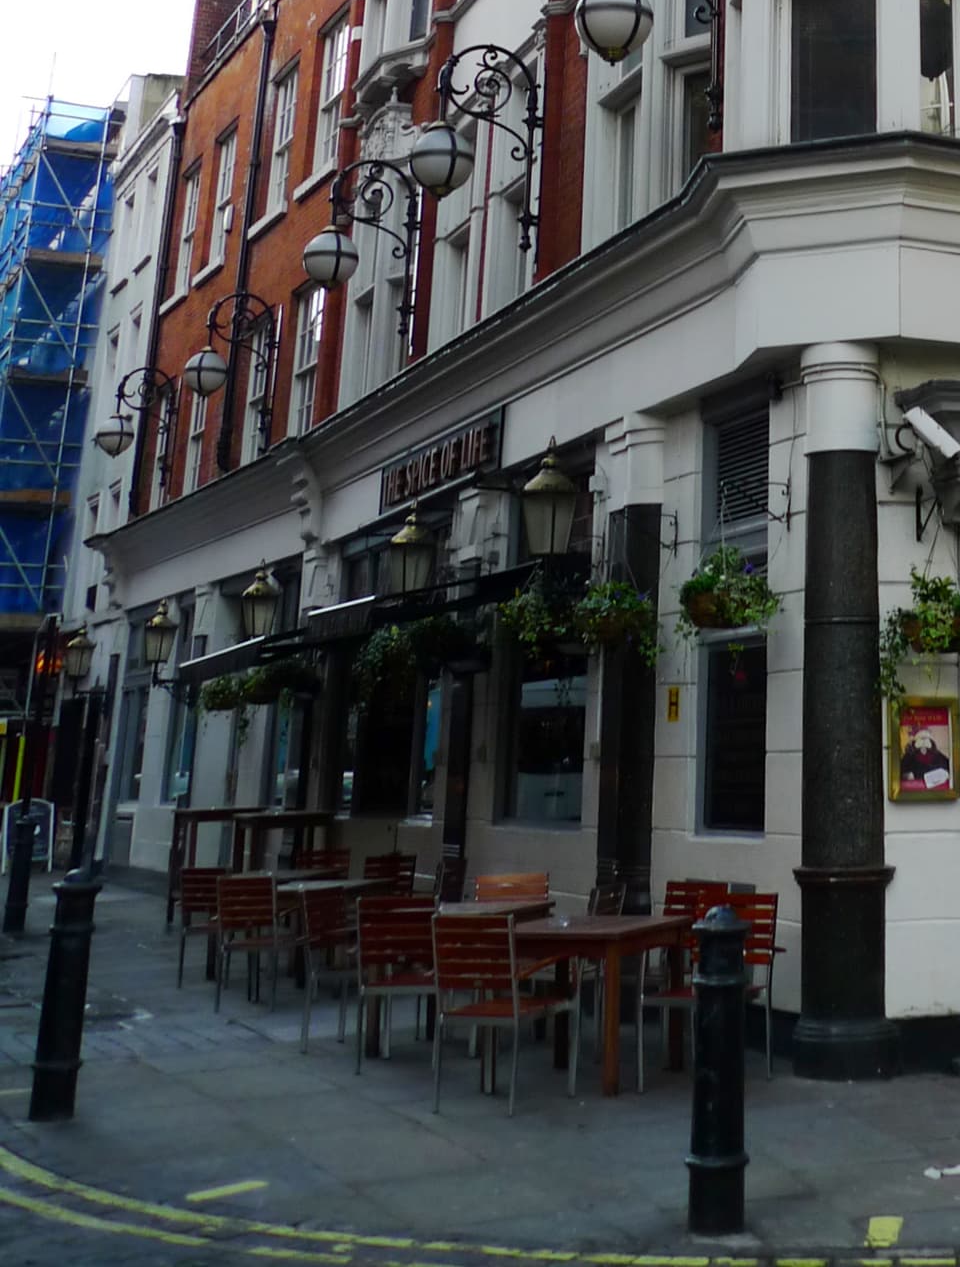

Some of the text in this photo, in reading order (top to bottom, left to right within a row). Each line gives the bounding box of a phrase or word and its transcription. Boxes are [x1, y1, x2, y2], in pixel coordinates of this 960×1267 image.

[382, 426, 489, 505] THE SPICE OF LIFE
